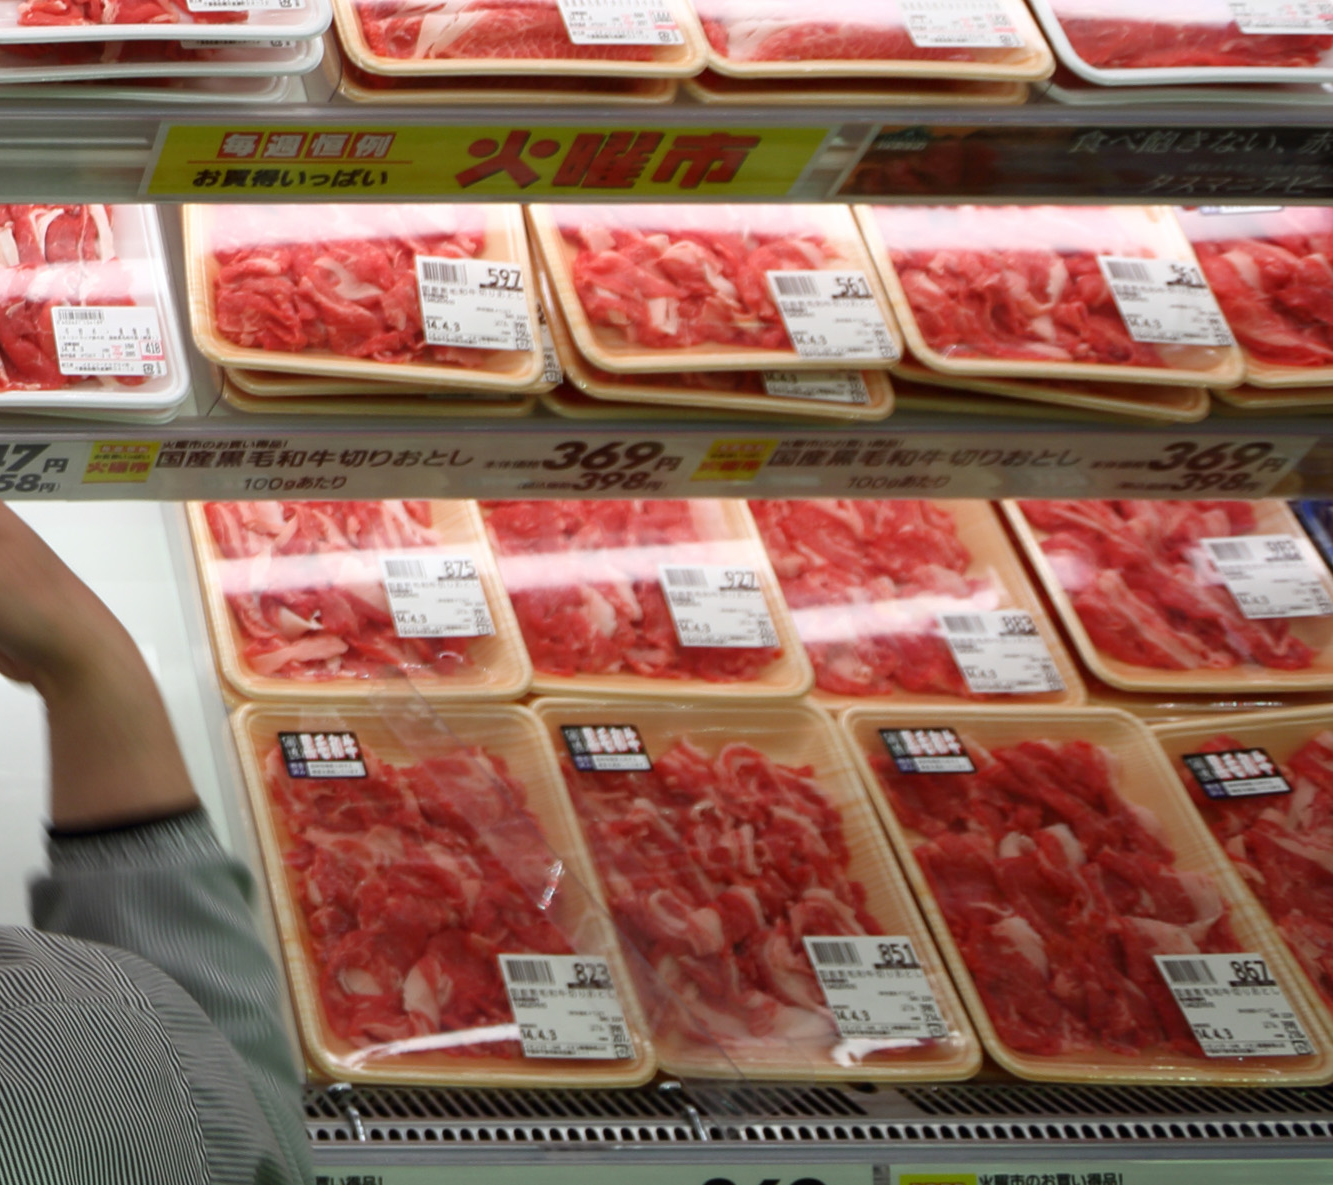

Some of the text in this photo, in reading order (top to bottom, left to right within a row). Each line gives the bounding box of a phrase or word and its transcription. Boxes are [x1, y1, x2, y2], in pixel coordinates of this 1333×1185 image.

[219, 133, 395, 158] 毎週恒例
[455, 129, 761, 190] 火曜市
[193, 169, 388, 190] お買得いっぱい
[488, 268, 522, 288] 597
[156, 449, 473, 471] 国産黒毛和牛切りおとし
[541, 441, 680, 473] 369円
[767, 448, 1083, 470] 国産黒毛和牛切りおとし
[1148, 442, 1285, 474] 369円
[243, 475, 347, 493] 100gあたり
[574, 963, 611, 984] 823
[1231, 960, 1268, 982] 867
